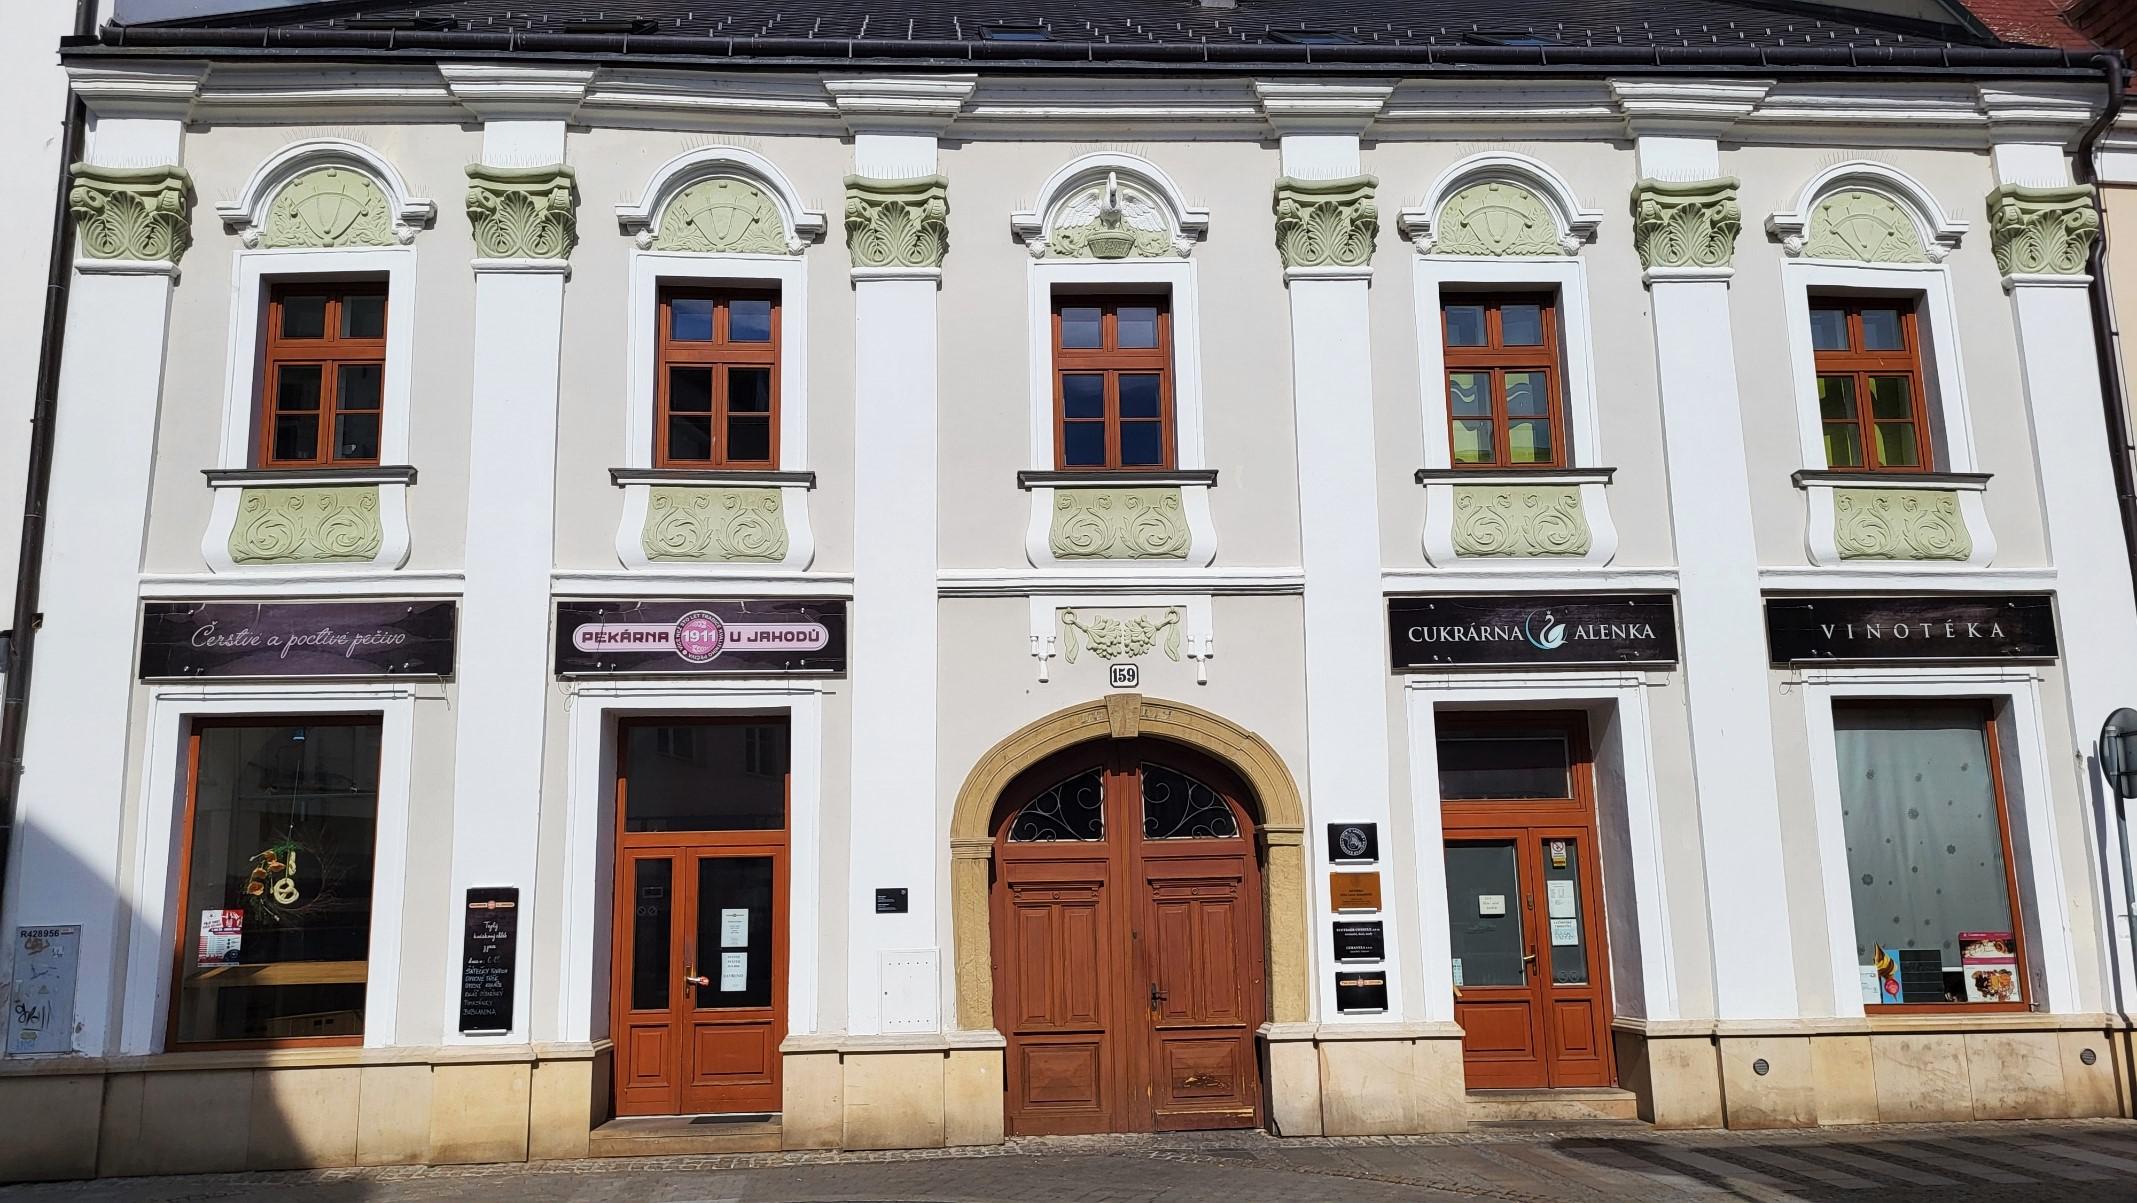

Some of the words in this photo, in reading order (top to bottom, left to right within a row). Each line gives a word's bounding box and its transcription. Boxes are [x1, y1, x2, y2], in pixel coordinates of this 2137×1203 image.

[680, 618, 689, 626] STO
[702, 614, 721, 628] TRADICE
[582, 629, 669, 643] PEKÁRNA
[730, 631, 741, 643] U
[747, 628, 820, 643] JAHODŮ
[681, 630, 717, 642] 1911
[1408, 622, 1525, 643] CUKRÁRNA
[1573, 623, 1657, 640] ALENKA
[1820, 619, 2005, 640] VINOTÉKA
[191, 621, 261, 647] Čerstvé
[267, 634, 283, 646] a
[280, 627, 349, 659] poctivé
[345, 630, 406, 658] pečivo
[1112, 668, 1136, 683] 159
[20, 929, 60, 938] R428956
